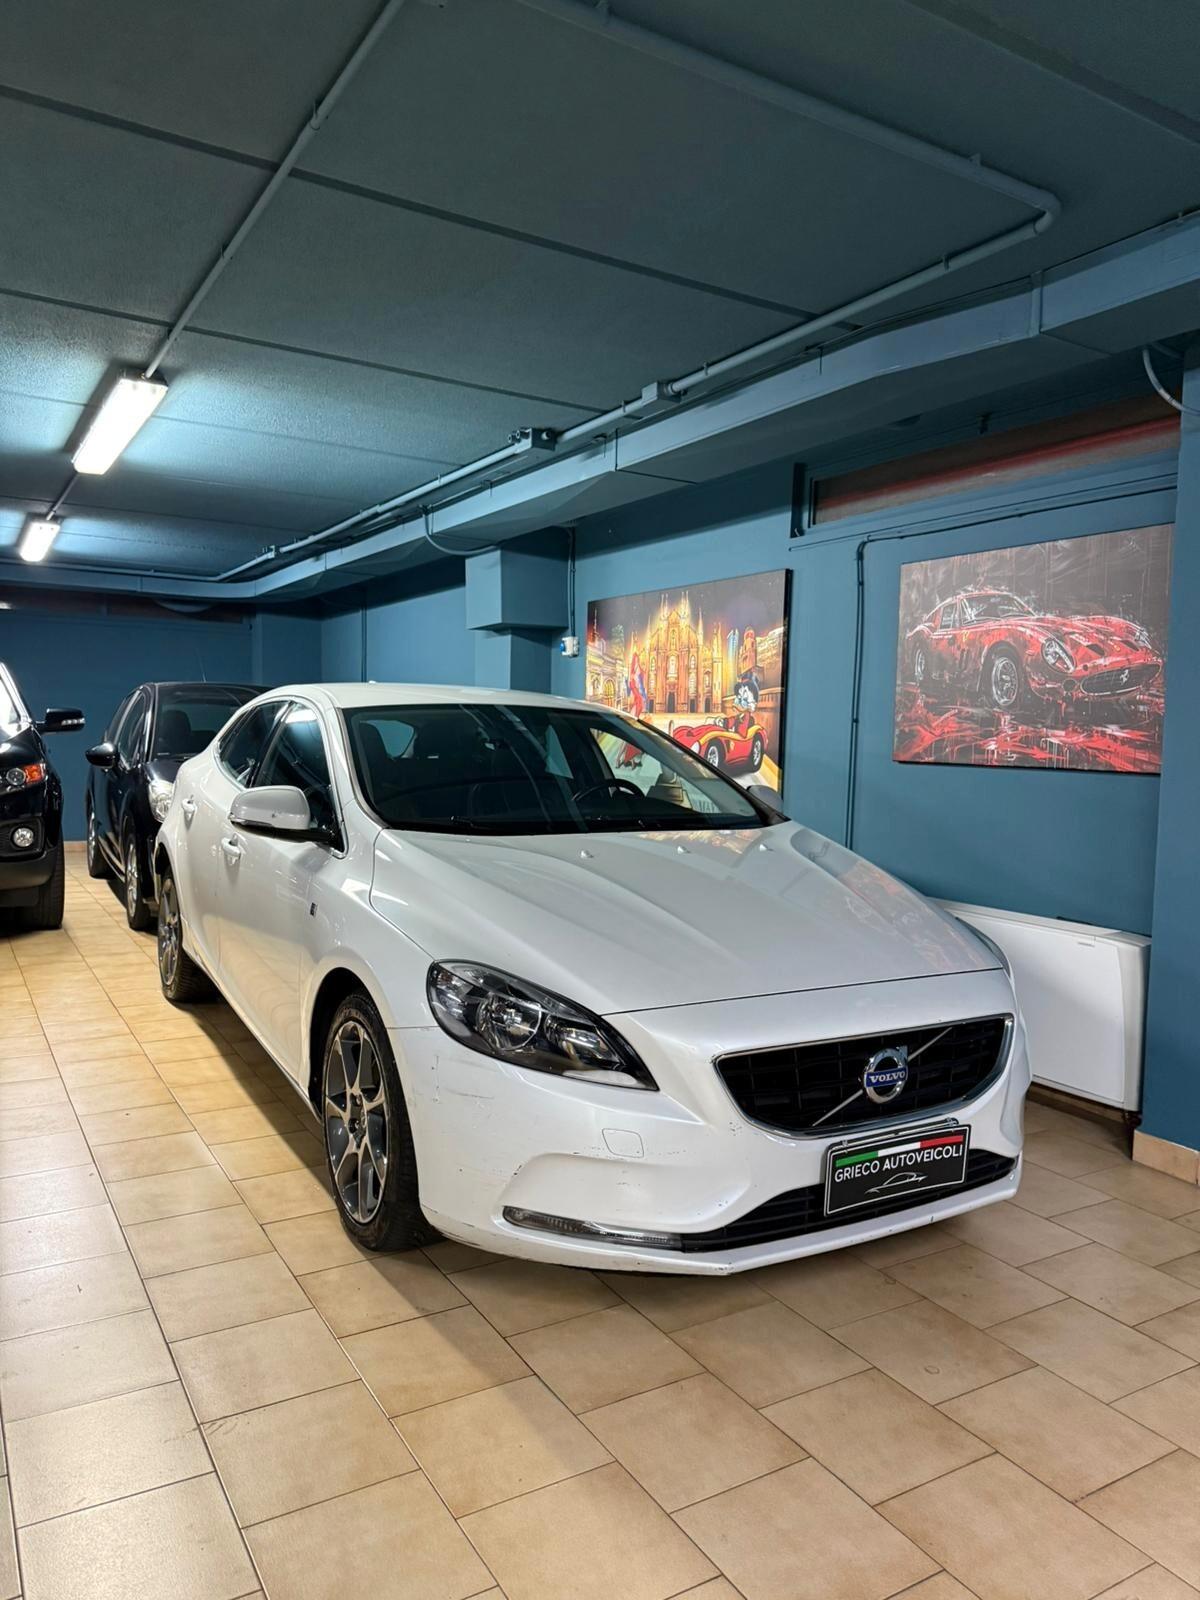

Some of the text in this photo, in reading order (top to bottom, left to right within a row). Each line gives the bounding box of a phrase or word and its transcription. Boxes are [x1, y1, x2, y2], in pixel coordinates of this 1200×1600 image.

[869, 1071, 906, 1083] VOLVO
[834, 1144, 963, 1182] GRIECO AUTOVEICOLI
